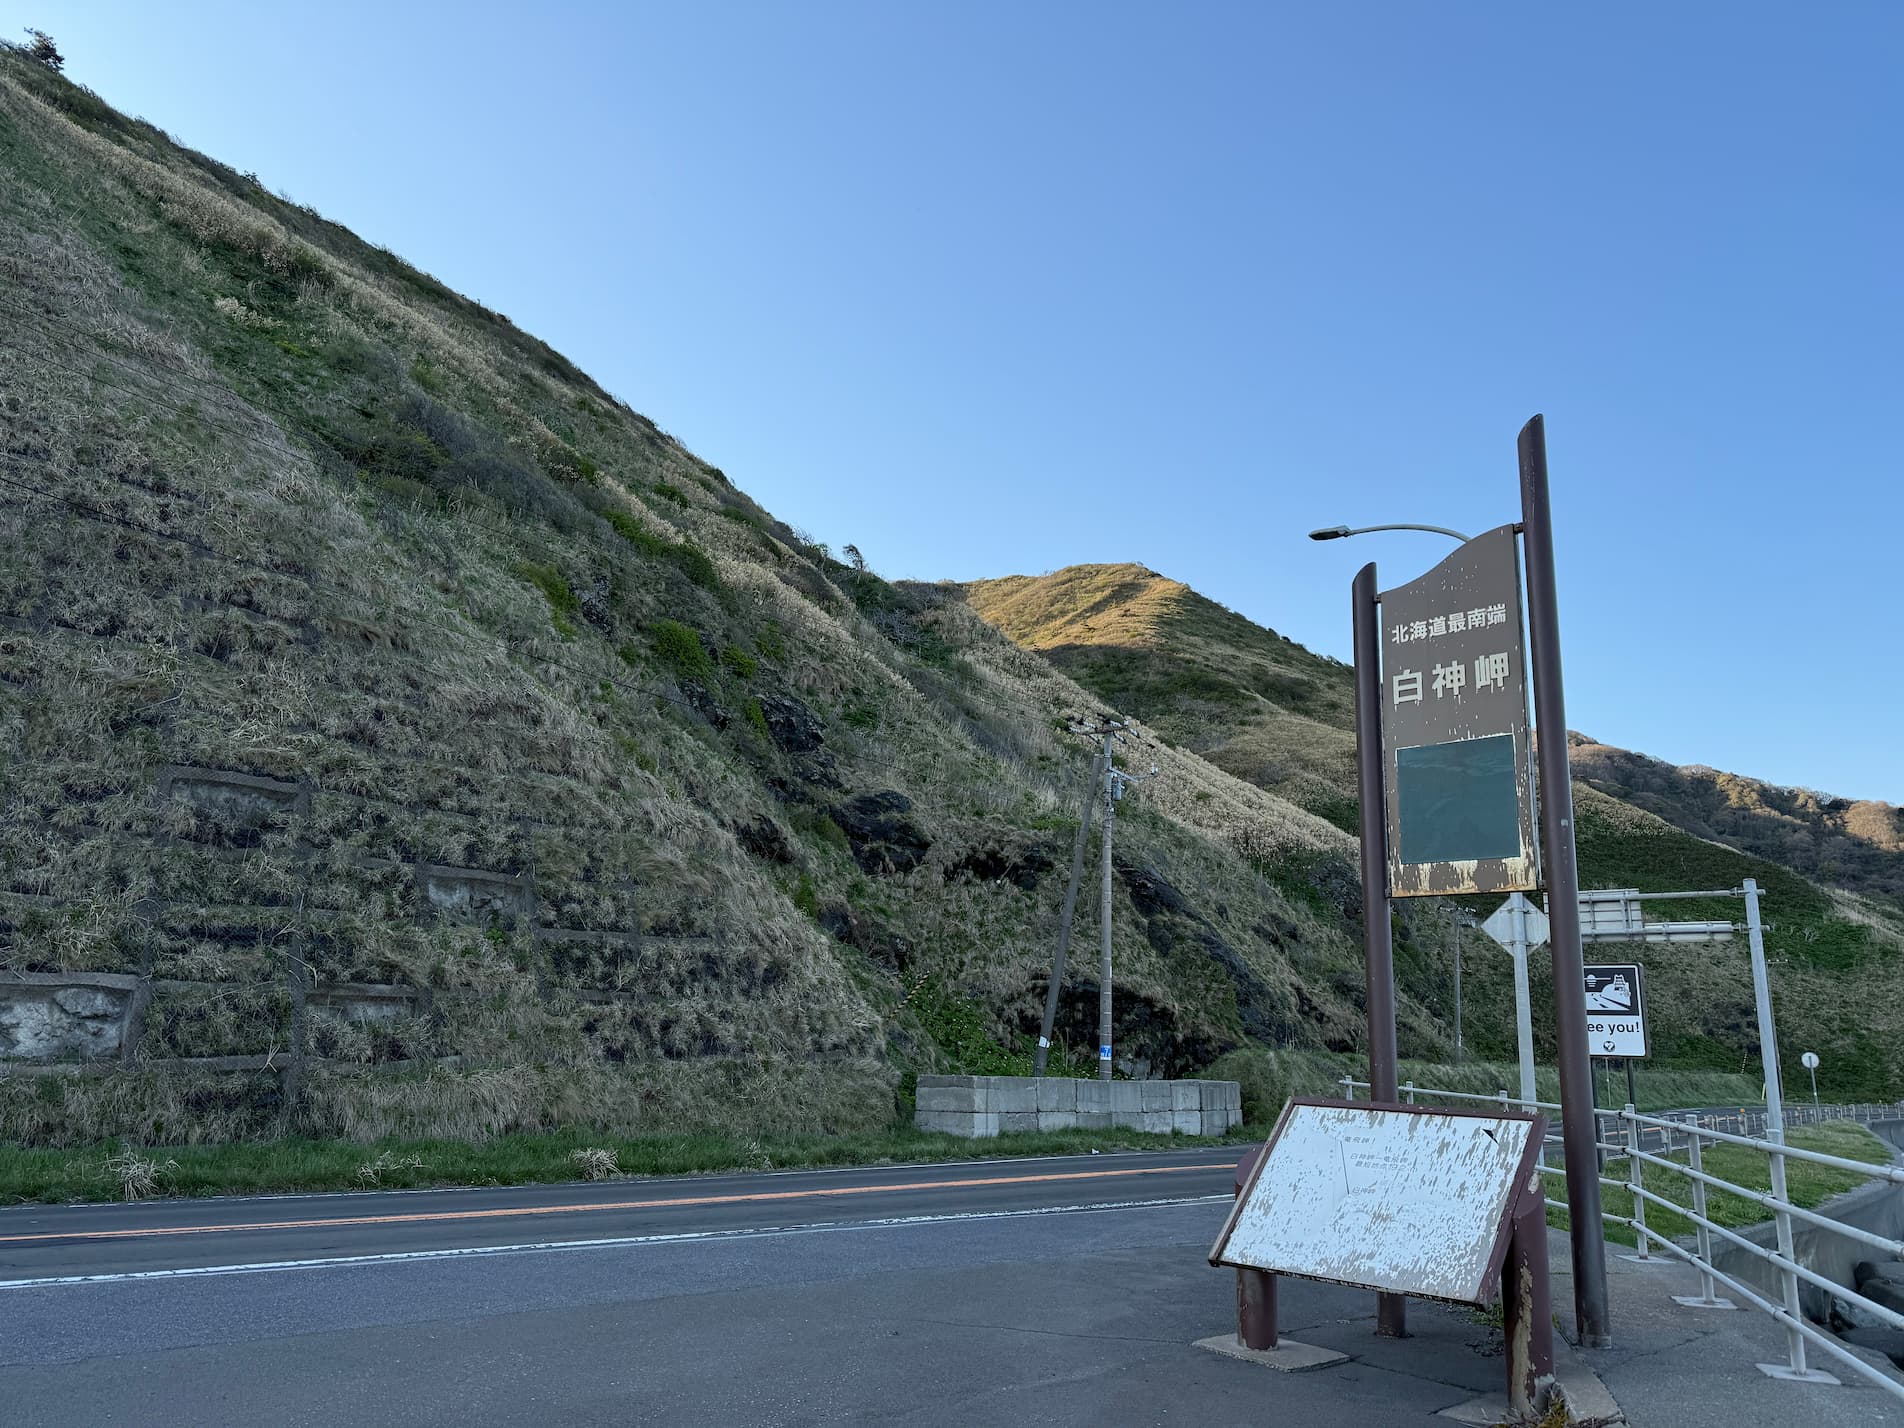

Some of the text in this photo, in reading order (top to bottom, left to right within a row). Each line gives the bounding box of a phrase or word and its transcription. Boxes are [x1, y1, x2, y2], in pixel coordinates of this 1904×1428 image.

[1391, 603, 1507, 644] 北海道最南端
[1392, 652, 1510, 705] 白神岬
[1587, 1021, 1640, 1036] ee you!
